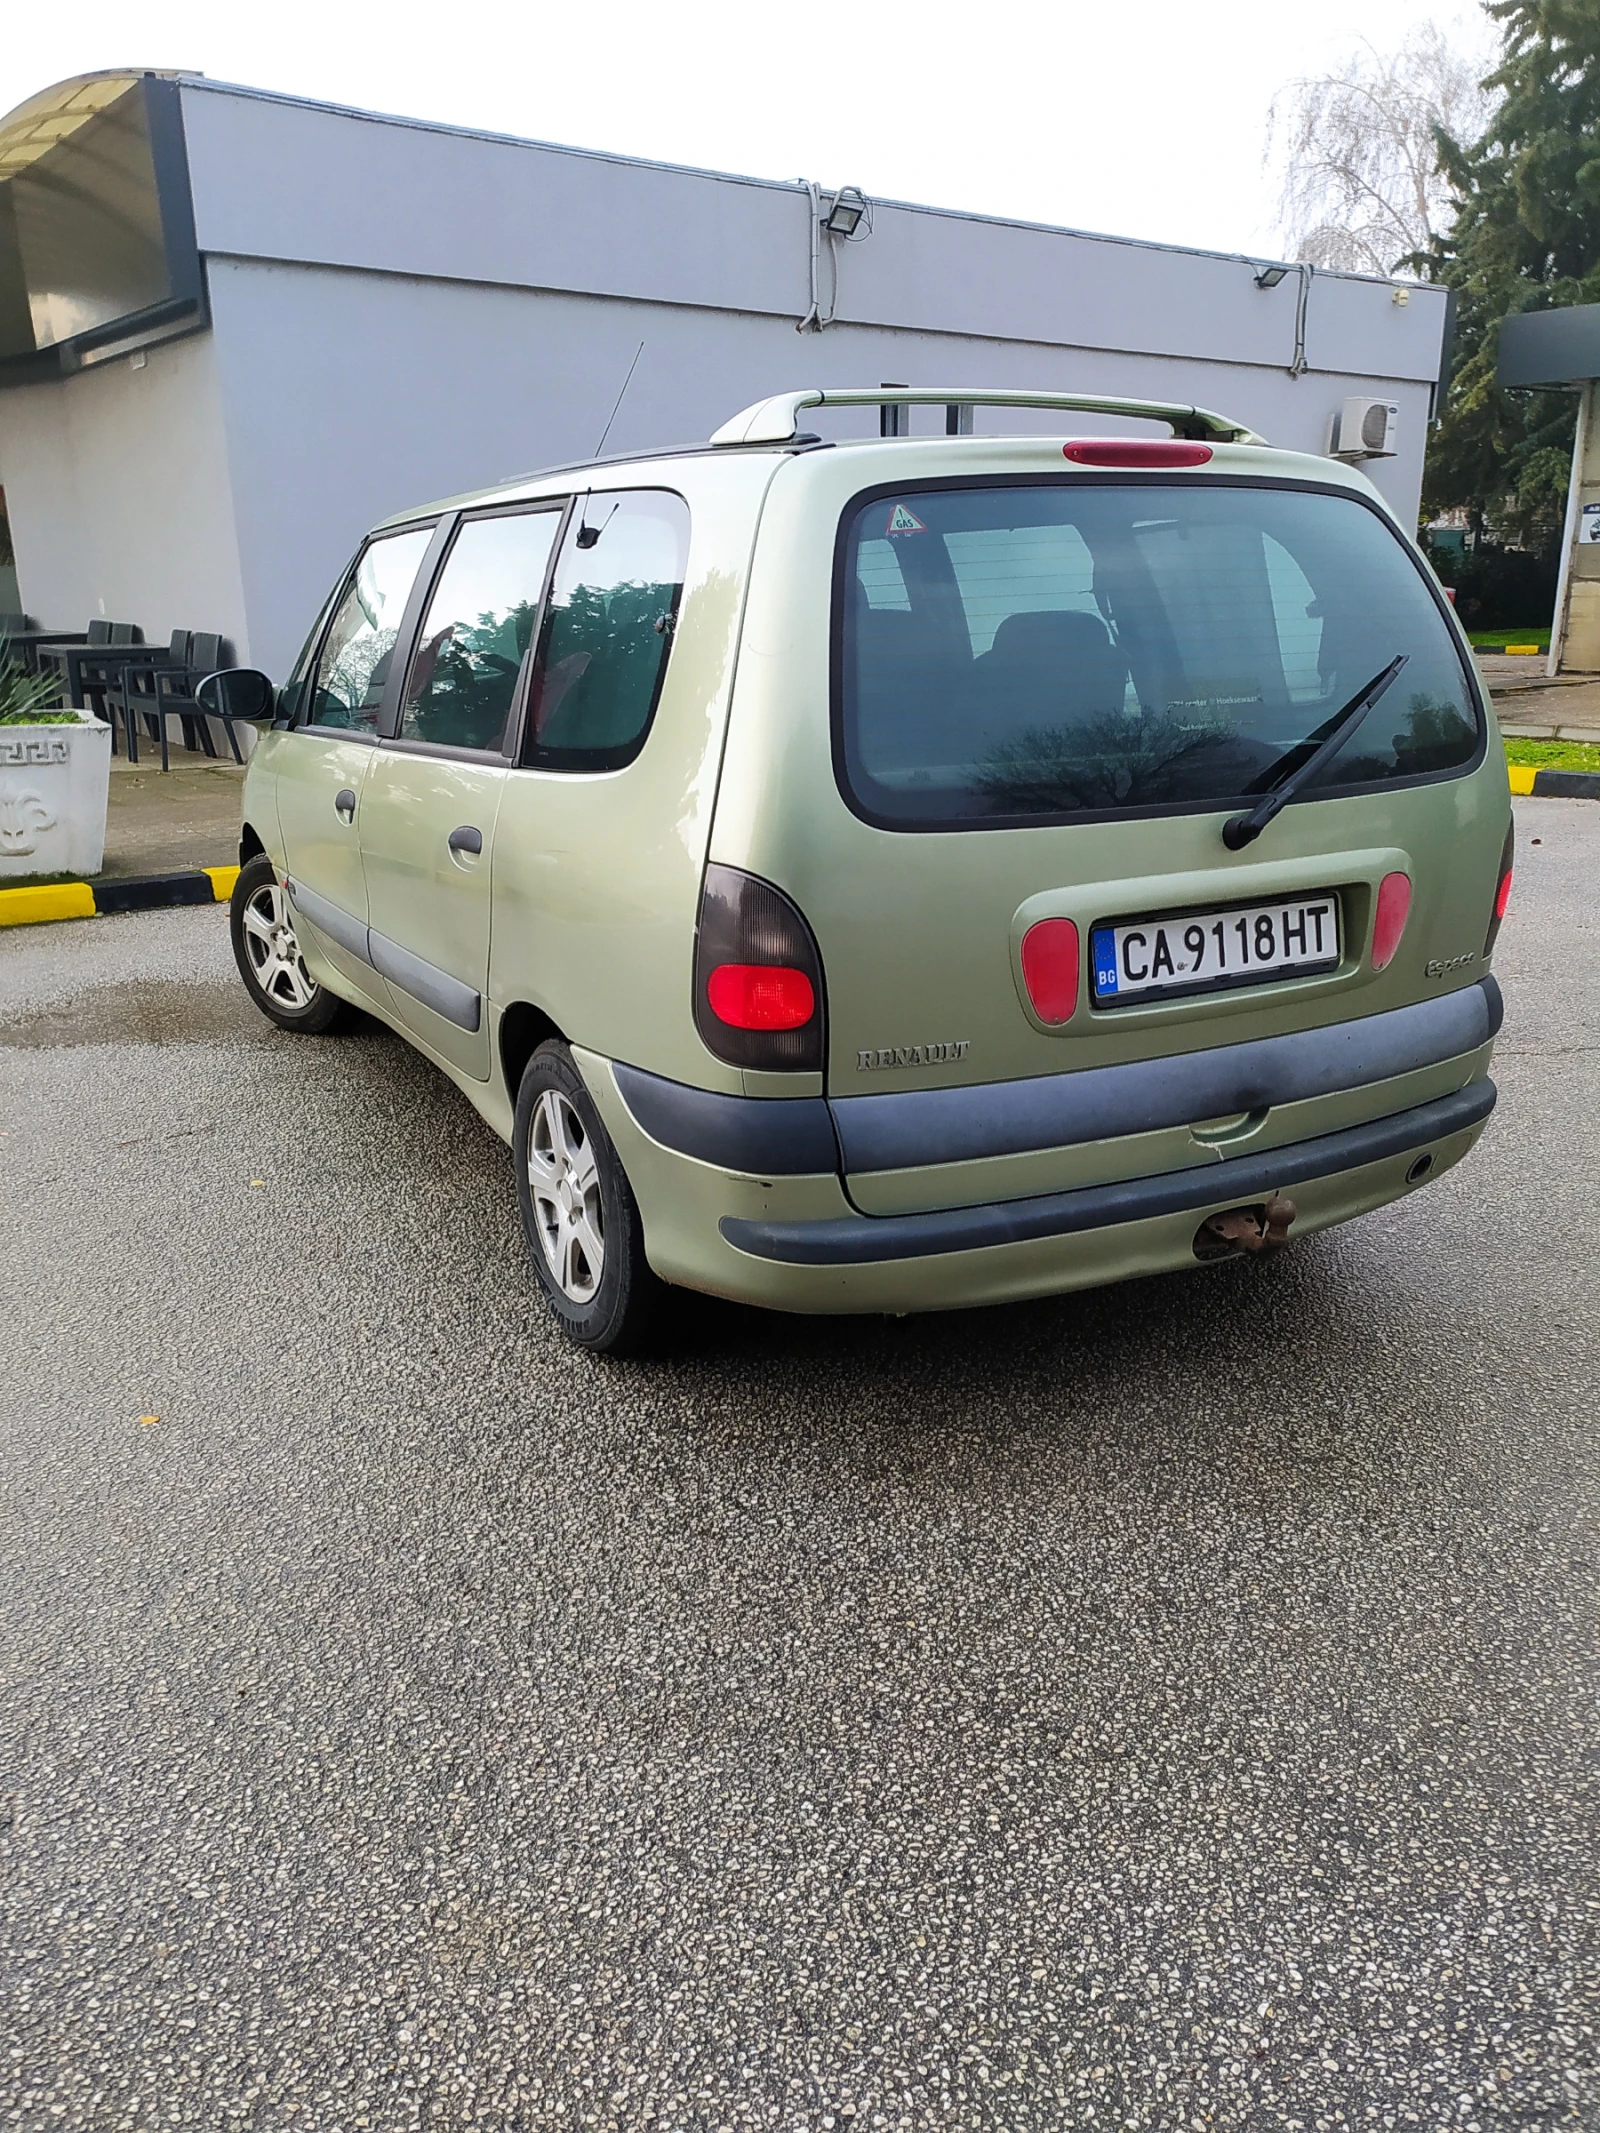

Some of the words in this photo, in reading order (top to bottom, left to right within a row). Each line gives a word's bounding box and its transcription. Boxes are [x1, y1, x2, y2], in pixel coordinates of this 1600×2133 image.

[896, 519, 913, 528] GAS
[1098, 970, 1116, 986] BG
[857, 1040, 971, 1071] RENAULT
